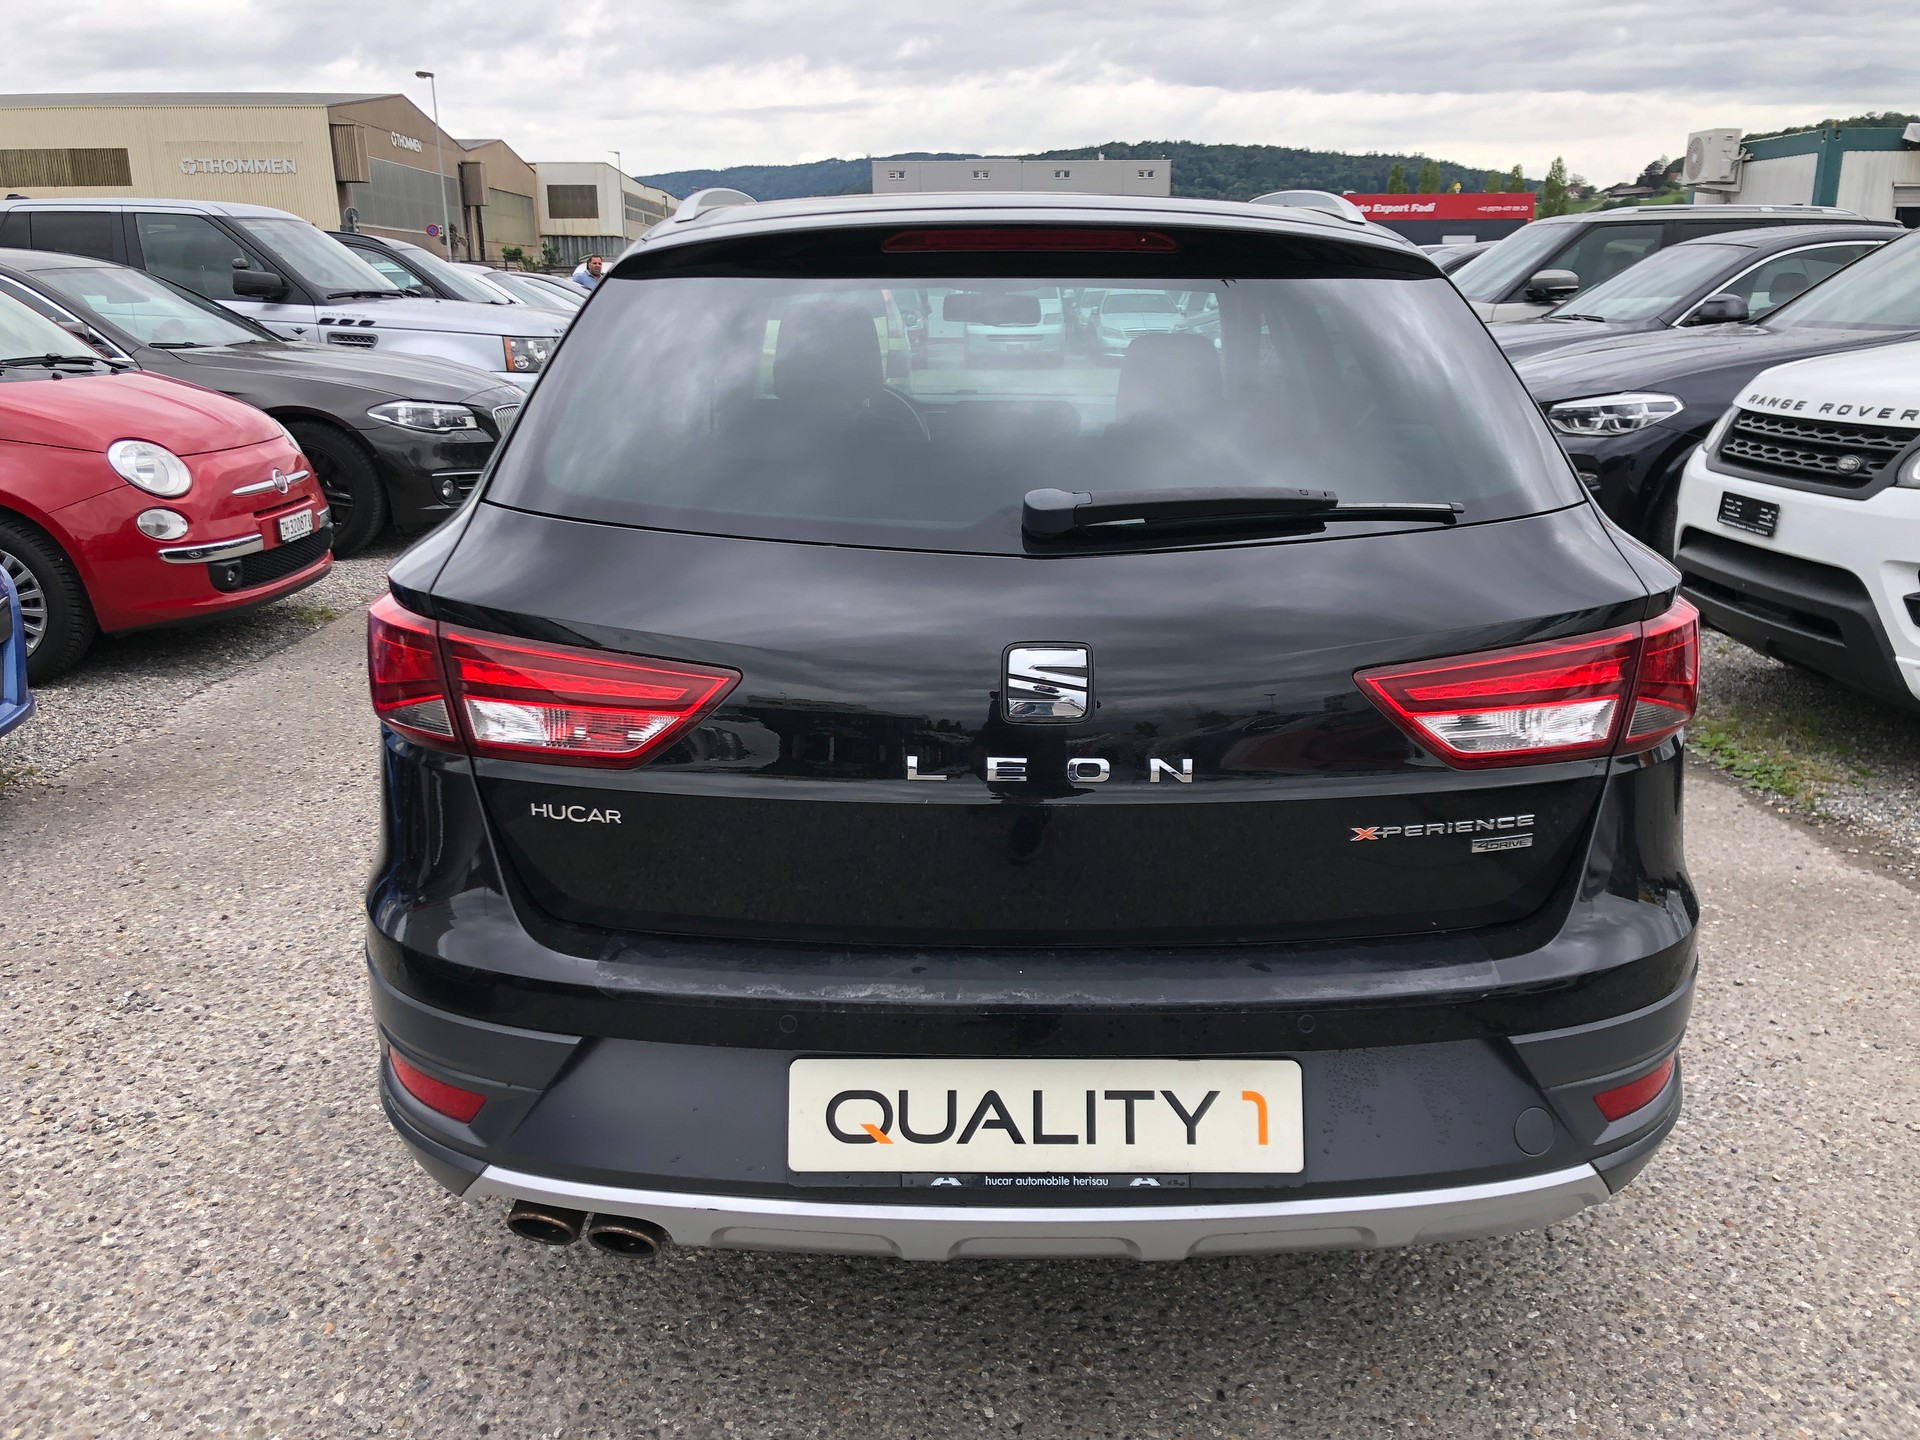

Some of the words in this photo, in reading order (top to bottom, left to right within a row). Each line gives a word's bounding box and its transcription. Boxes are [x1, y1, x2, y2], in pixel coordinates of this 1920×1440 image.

[197, 158, 297, 174] THOMMEN
[1373, 203, 1409, 215] Export
[1411, 202, 1436, 213] Fadi
[1747, 394, 1808, 411] RANGE
[1818, 402, 1919, 421] ROVER
[906, 755, 1194, 783] LEON
[530, 802, 622, 824] HUCAR
[1350, 814, 1536, 842] XPERIENCE
[1474, 838, 1530, 851] 4DRIVE
[825, 1089, 1221, 1145] QUALITY
[1241, 1090, 1269, 1146] 1
[984, 1175, 1013, 1187] hucar
[1015, 1175, 1070, 1187] automobile
[1072, 1175, 1109, 1187] herisau
